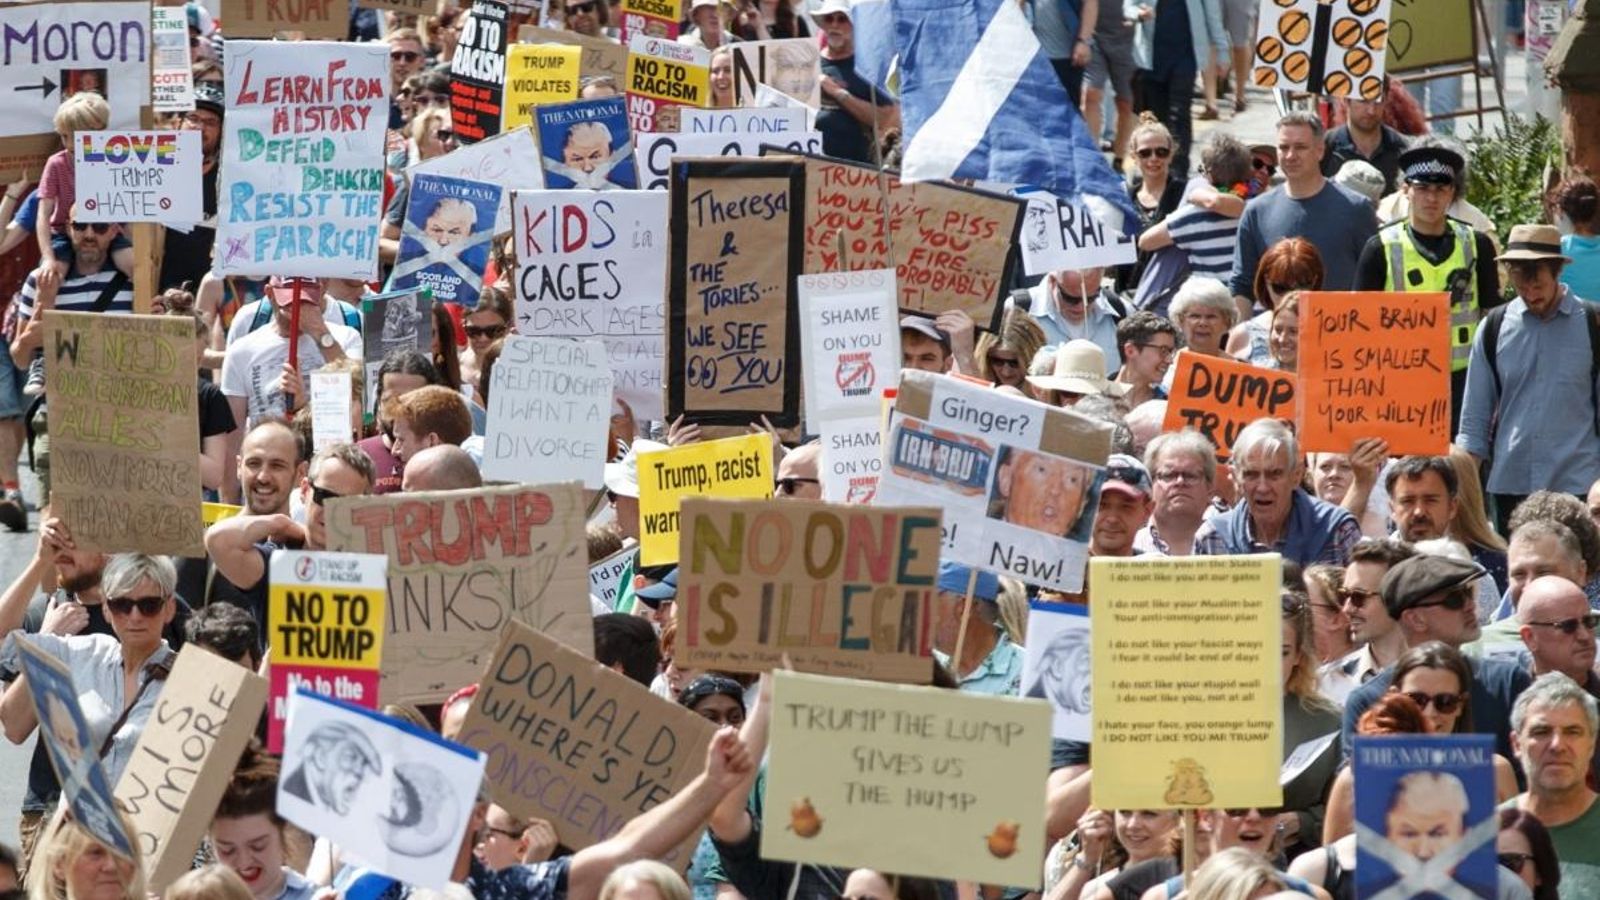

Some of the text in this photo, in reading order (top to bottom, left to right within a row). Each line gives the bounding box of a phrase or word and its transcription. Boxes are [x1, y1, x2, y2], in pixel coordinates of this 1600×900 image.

[480, 20, 500, 51] TO
[626, 14, 645, 29] NO
[4, 19, 145, 66] Moron
[452, 44, 504, 84] RACISM
[523, 56, 565, 69] TRUMP
[634, 57, 658, 77] NO
[664, 63, 686, 81] TO
[236, 59, 384, 105] LEARN FROM
[512, 80, 571, 93] VIOLATES
[633, 75, 698, 101] RACISM
[271, 104, 372, 135] HISTORY
[630, 96, 655, 116] NO
[630, 113, 652, 131] TO
[82, 134, 178, 166] LOVE
[238, 128, 336, 165] DEFEND
[109, 167, 164, 187] TRUMPS
[96, 191, 156, 217] HATE
[229, 181, 378, 223] RESIST THE
[690, 189, 788, 228] Theresa
[524, 200, 652, 257] KIDS in
[815, 210, 865, 228] YOU
[919, 226, 970, 251] YOU
[943, 211, 998, 238] PISS
[255, 222, 378, 263] FAR RIGHT
[719, 231, 738, 257] &
[852, 239, 888, 254] ON
[520, 259, 622, 301] CAGES
[689, 262, 727, 283] THE
[534, 303, 665, 336] DARK AGES
[821, 306, 880, 326] SHAME
[1316, 300, 1437, 346] YOUR BRAIN
[686, 321, 767, 351] WE SEE
[823, 333, 882, 351] ON YOU
[55, 329, 176, 375] WE NEED
[1323, 349, 1442, 372] IS SMALLER
[494, 367, 612, 396] RELATIONSHIP
[731, 356, 782, 385] YOU
[1187, 362, 1294, 414] DUMP
[1322, 378, 1386, 398] THAN
[499, 400, 600, 424] I WANT A
[941, 397, 1031, 436] Ginger?
[1318, 404, 1367, 433] YOUR
[495, 432, 594, 460] DIVORCE
[831, 431, 881, 449] SHAM
[58, 450, 192, 497] NOW MORE
[654, 451, 761, 492] Trump, racist
[834, 458, 881, 475] ON YO
[63, 494, 199, 542] THAN EVER
[352, 491, 554, 566] TRUMP
[690, 510, 940, 586] NO ONE
[989, 541, 1064, 584] Naw!
[591, 566, 610, 585] I'd
[285, 591, 369, 626] NO TO
[685, 581, 934, 659] IS ILLEGAL
[278, 625, 374, 661] TRUMP
[315, 675, 331, 695] to
[334, 675, 363, 700] the
[495, 643, 676, 779] DONALD,
[785, 703, 1024, 747] TRUMP THE LUMP
[155, 684, 230, 814] MORE
[481, 686, 620, 784] WHERE'S
[1230, 733, 1269, 742] TRUMP
[852, 746, 965, 779] GIVES US
[844, 782, 977, 812] THE HUMP
